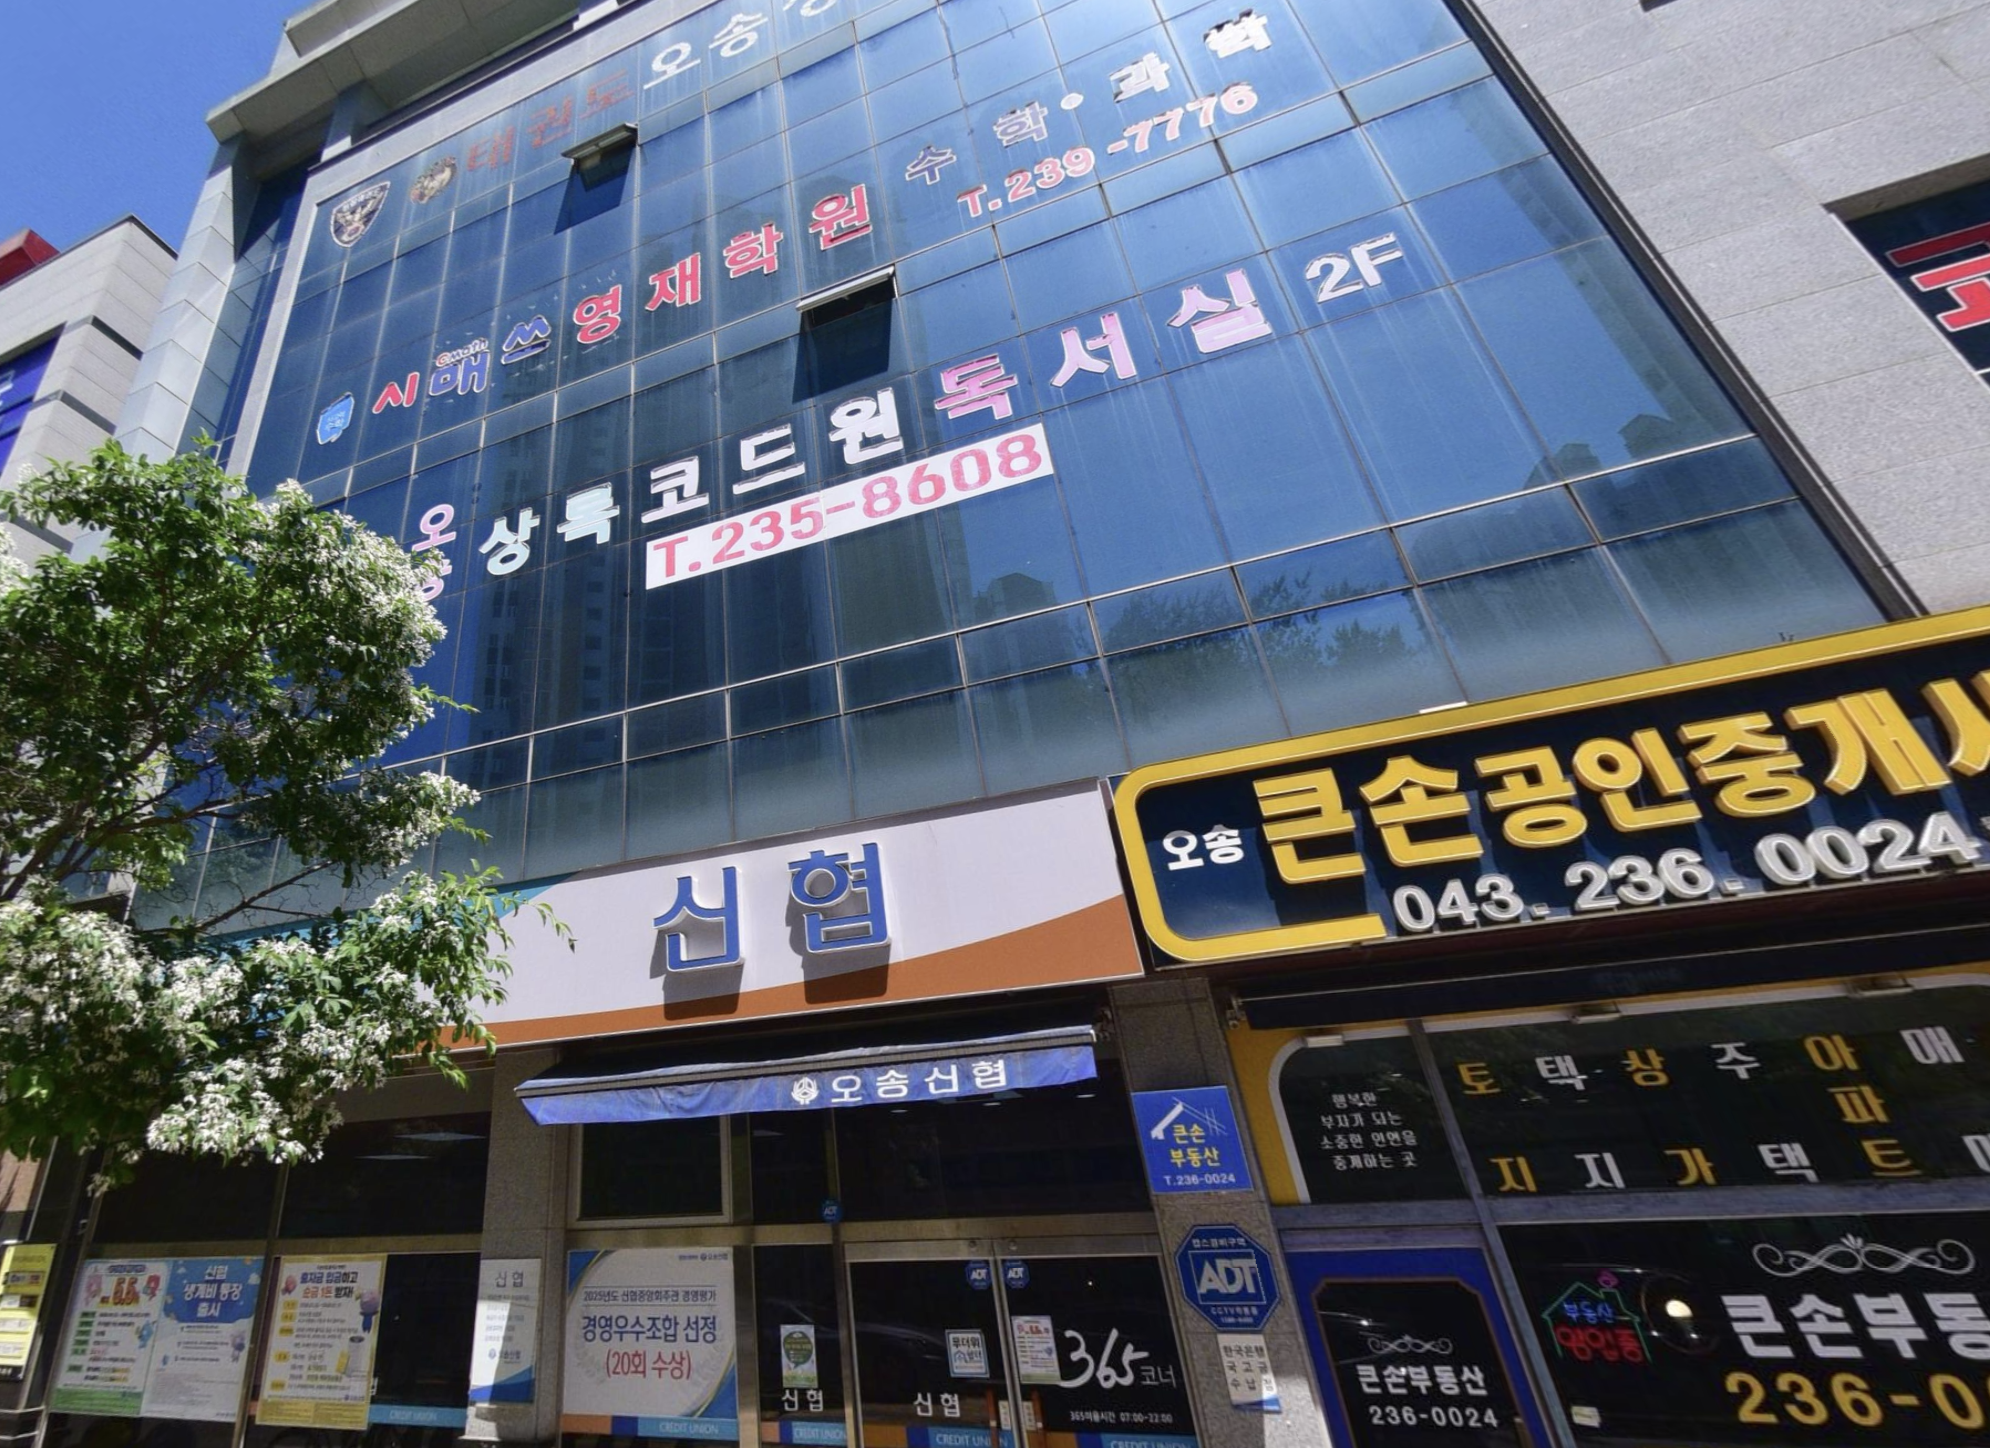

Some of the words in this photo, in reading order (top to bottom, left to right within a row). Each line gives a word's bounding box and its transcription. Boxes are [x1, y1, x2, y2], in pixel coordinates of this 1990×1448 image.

[1304, 232, 1402, 303] 2F
[653, 433, 1043, 579] T.235-8608
[1162, 822, 1244, 872] 오송
[653, 842, 891, 973] 신협
[1172, 1124, 1206, 1144] 큰손
[1170, 1147, 1221, 1168] 부동산
[1163, 1174, 1236, 1188] T.236-0024
[204, 1265, 228, 1280] 신협
[494, 1271, 524, 1288] 신협
[970, 1269, 988, 1280] ADT
[1007, 1268, 1024, 1280] ADT
[1197, 1258, 1258, 1294] ADT
[1563, 1300, 1616, 1325] 부동산
[582, 1314, 678, 1343] 경영우수조합
[684, 1315, 717, 1343] 선정
[606, 1349, 646, 1379] (20회
[652, 1349, 692, 1380] 수상)
[1059, 1328, 1149, 1389] 365
[1140, 1365, 1177, 1389] 코너
[1223, 1345, 1265, 1359] 한국은행
[1356, 1362, 1489, 1397] 큰손부동산
[781, 1388, 824, 1412] 신협
[913, 1392, 960, 1419] 신협
[1368, 1405, 1499, 1430] 236-0024
[936, 1433, 970, 1446] CREDIT
